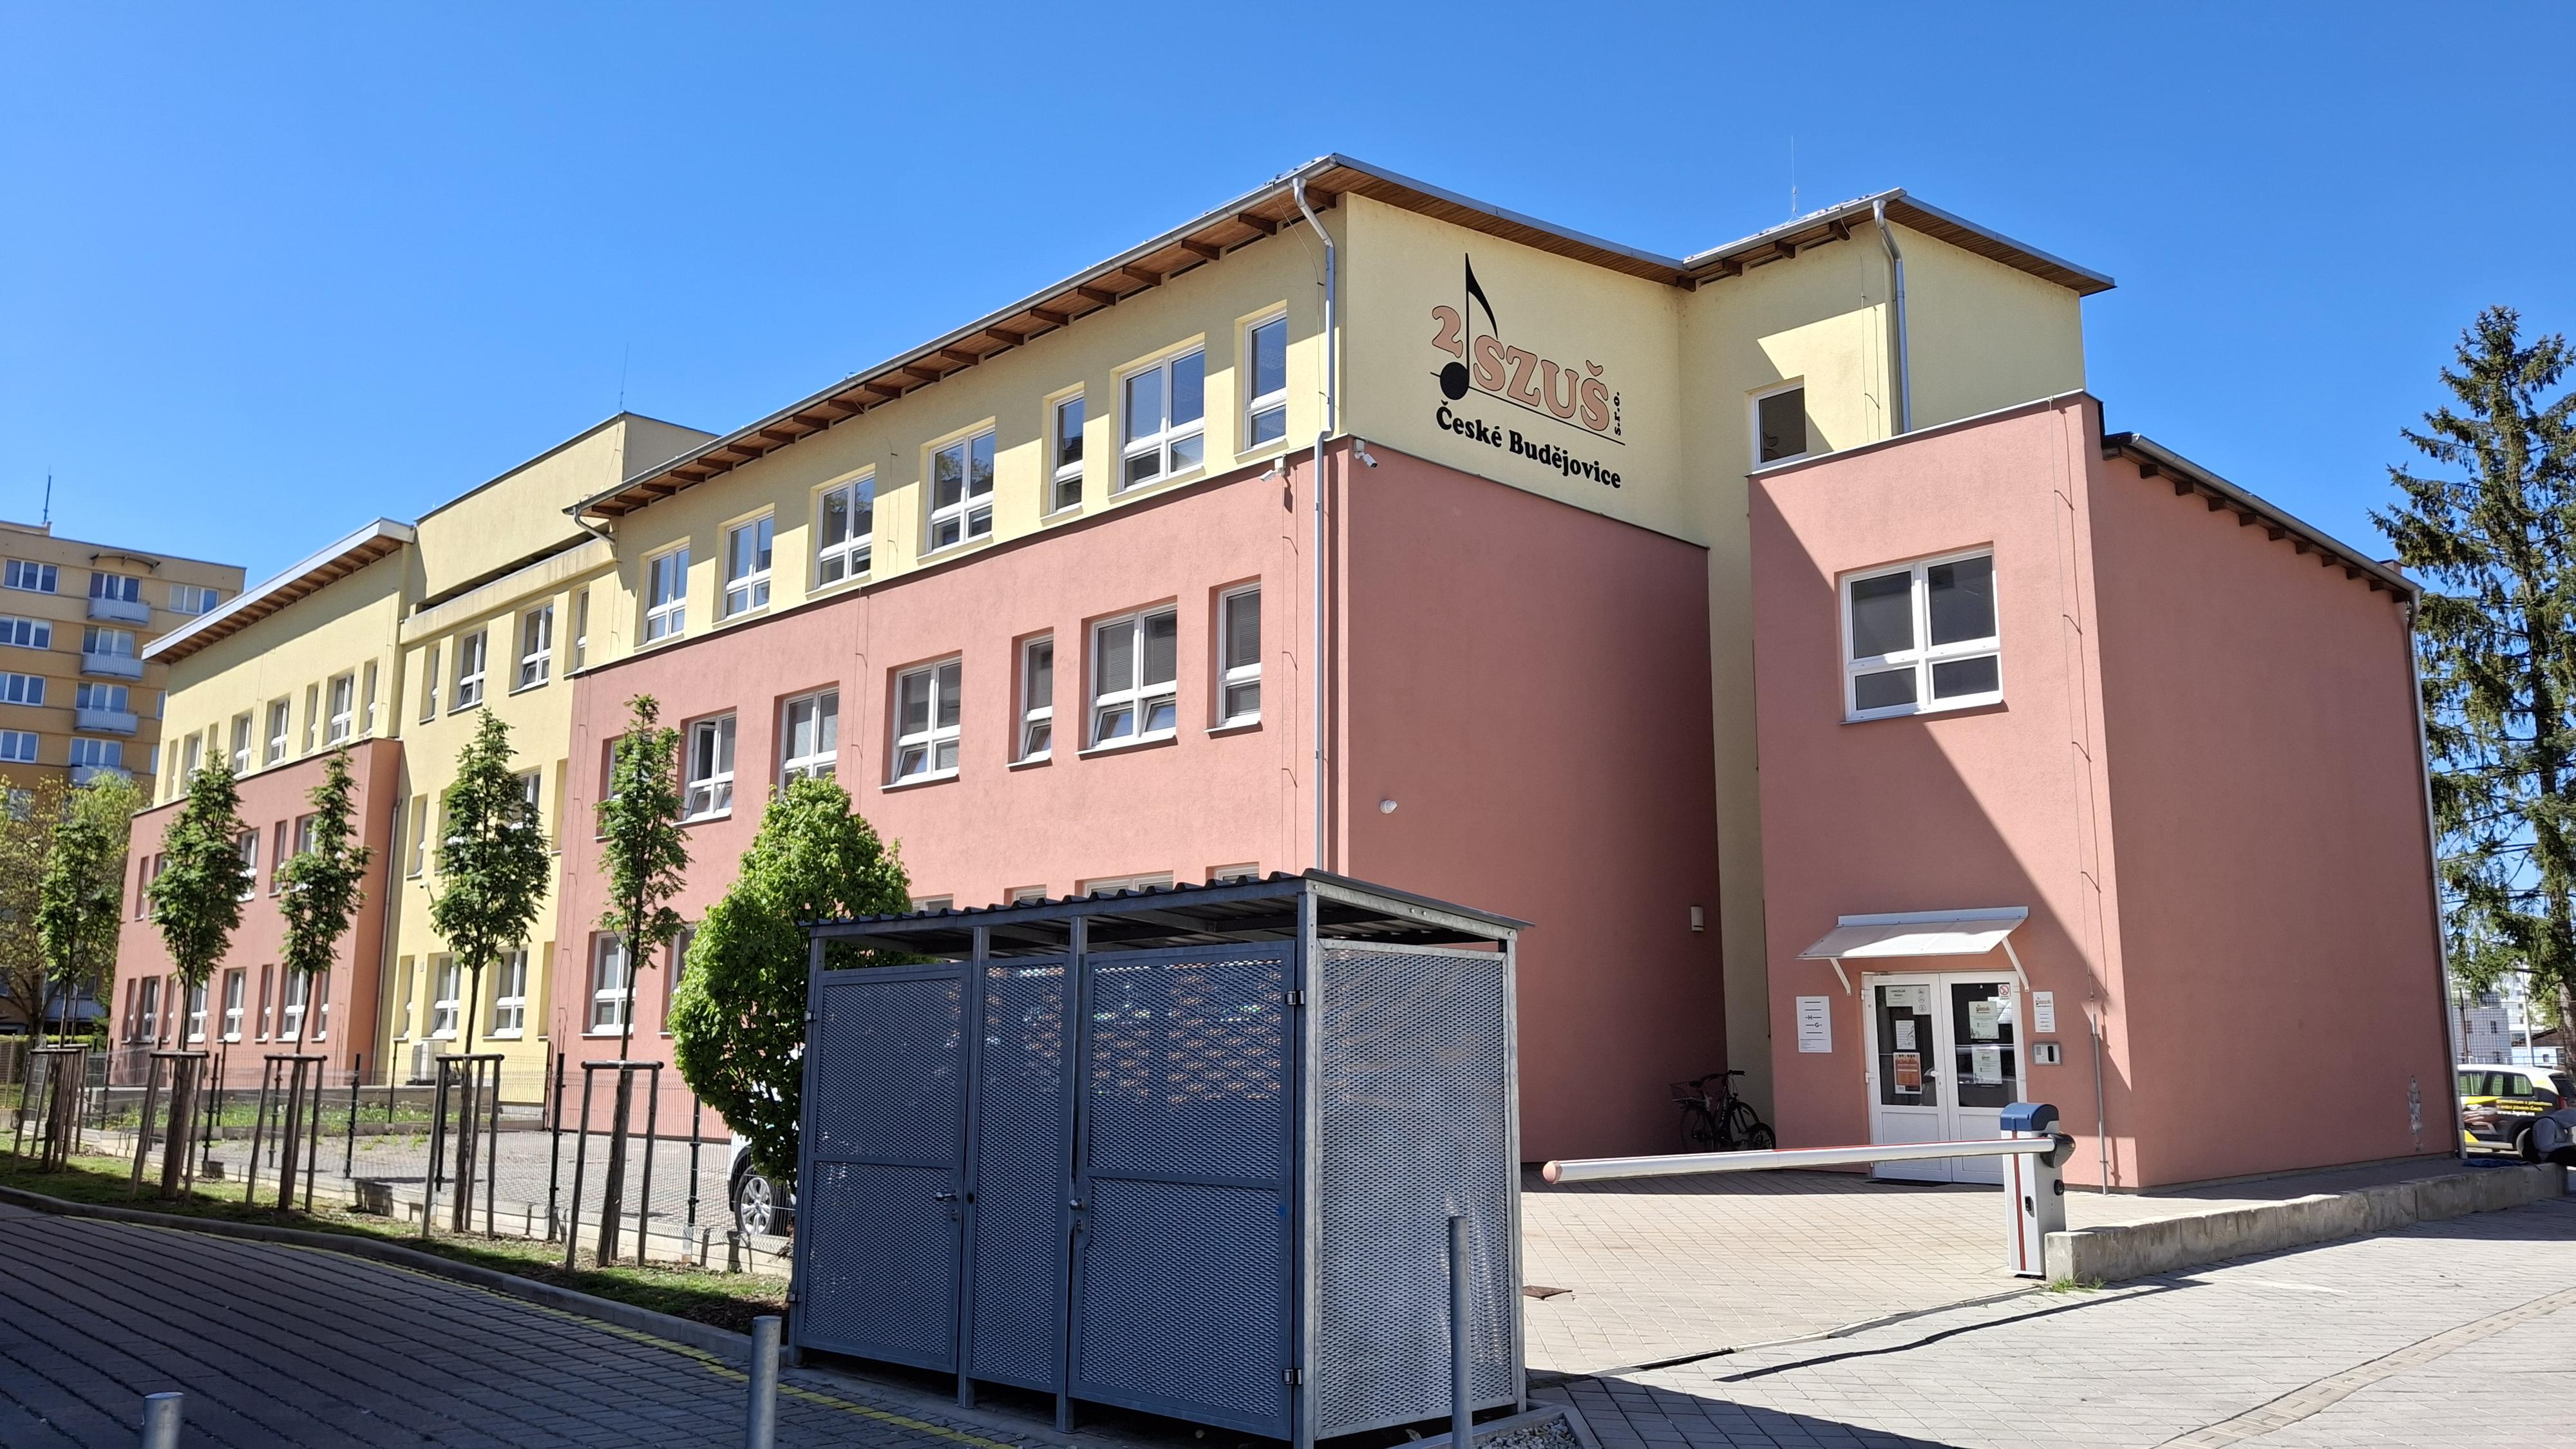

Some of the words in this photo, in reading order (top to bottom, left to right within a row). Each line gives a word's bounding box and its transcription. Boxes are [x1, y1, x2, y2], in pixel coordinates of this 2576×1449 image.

[1432, 305, 1463, 358] 2
[1473, 334, 1610, 431] SZUŠ
[1436, 400, 1502, 448] České
[1508, 430, 1621, 488] Budějovice
[1613, 391, 1622, 436] s.r.o.
